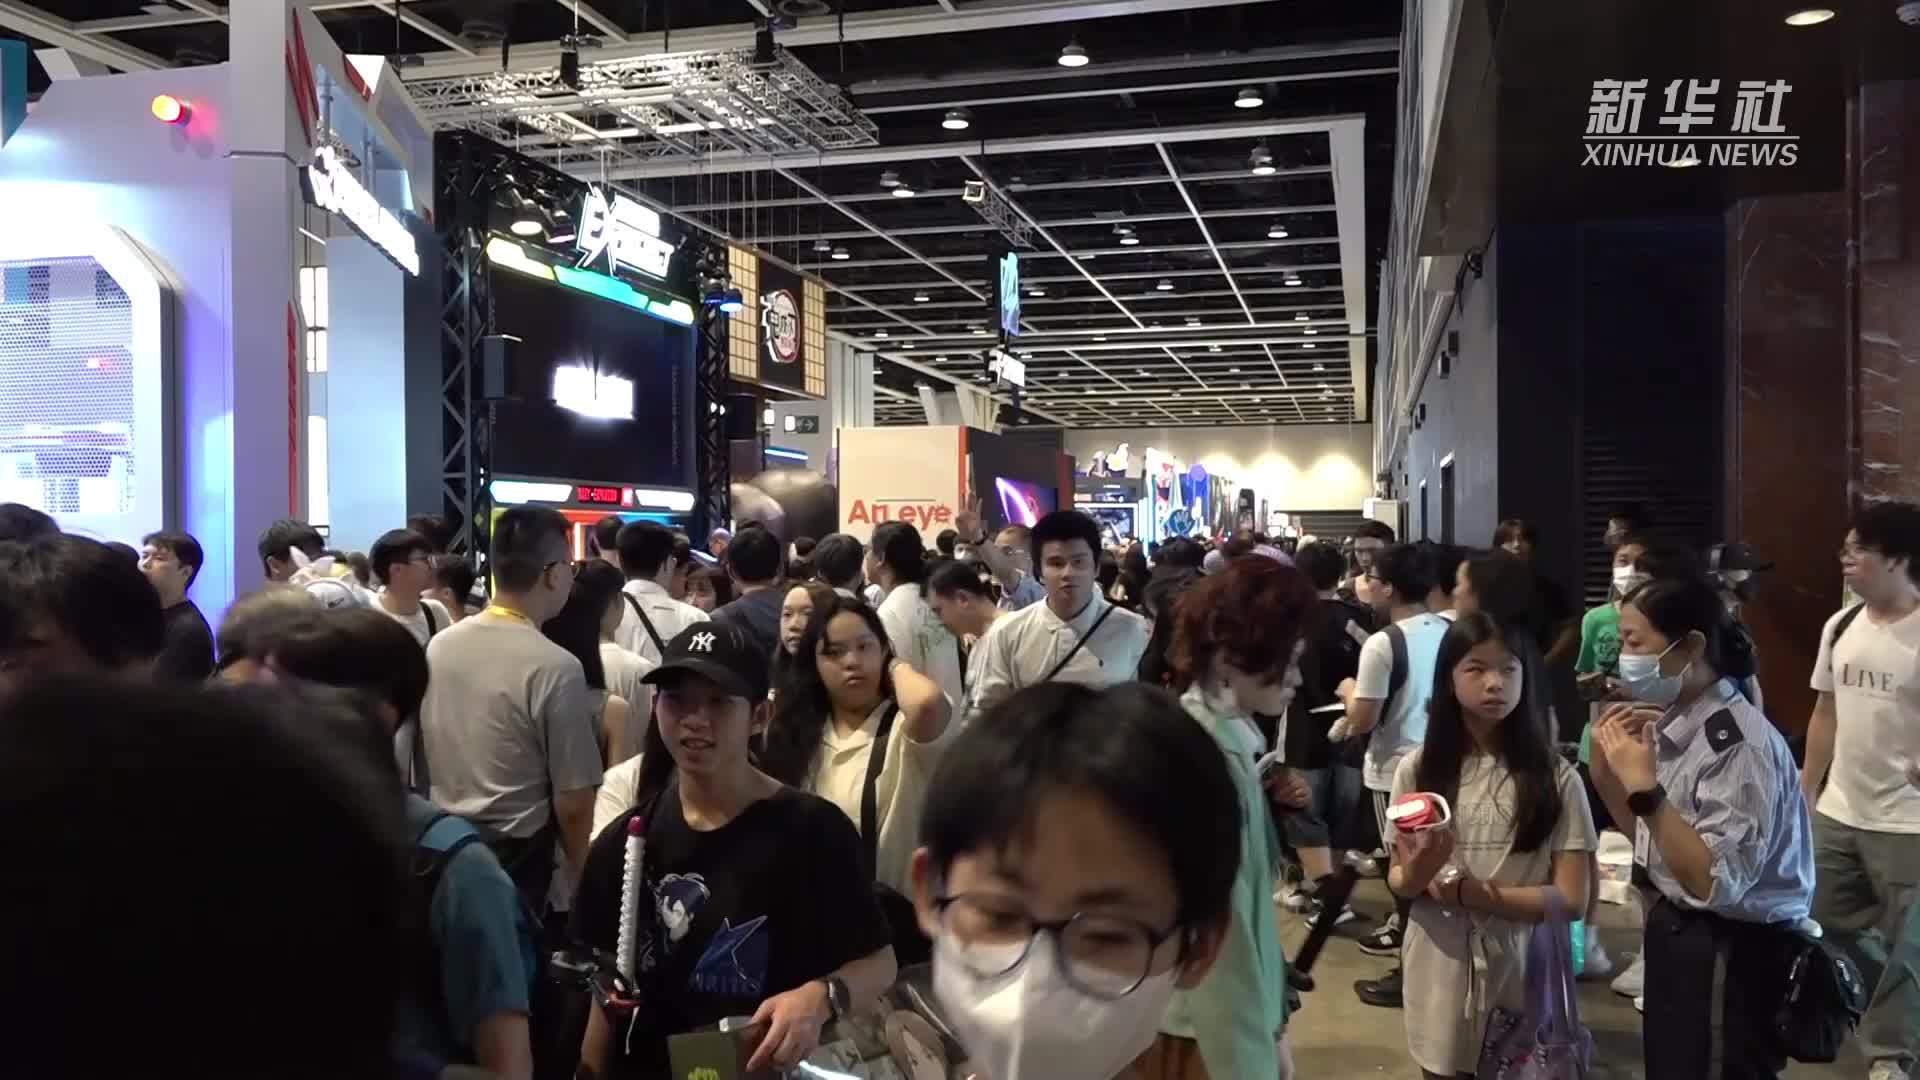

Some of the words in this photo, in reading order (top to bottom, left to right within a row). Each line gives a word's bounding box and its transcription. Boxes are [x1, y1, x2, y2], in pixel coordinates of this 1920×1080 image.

[847, 499, 888, 524] An
[898, 504, 952, 531] eye
[687, 631, 717, 652] NY
[1841, 663, 1895, 692] LIVE
